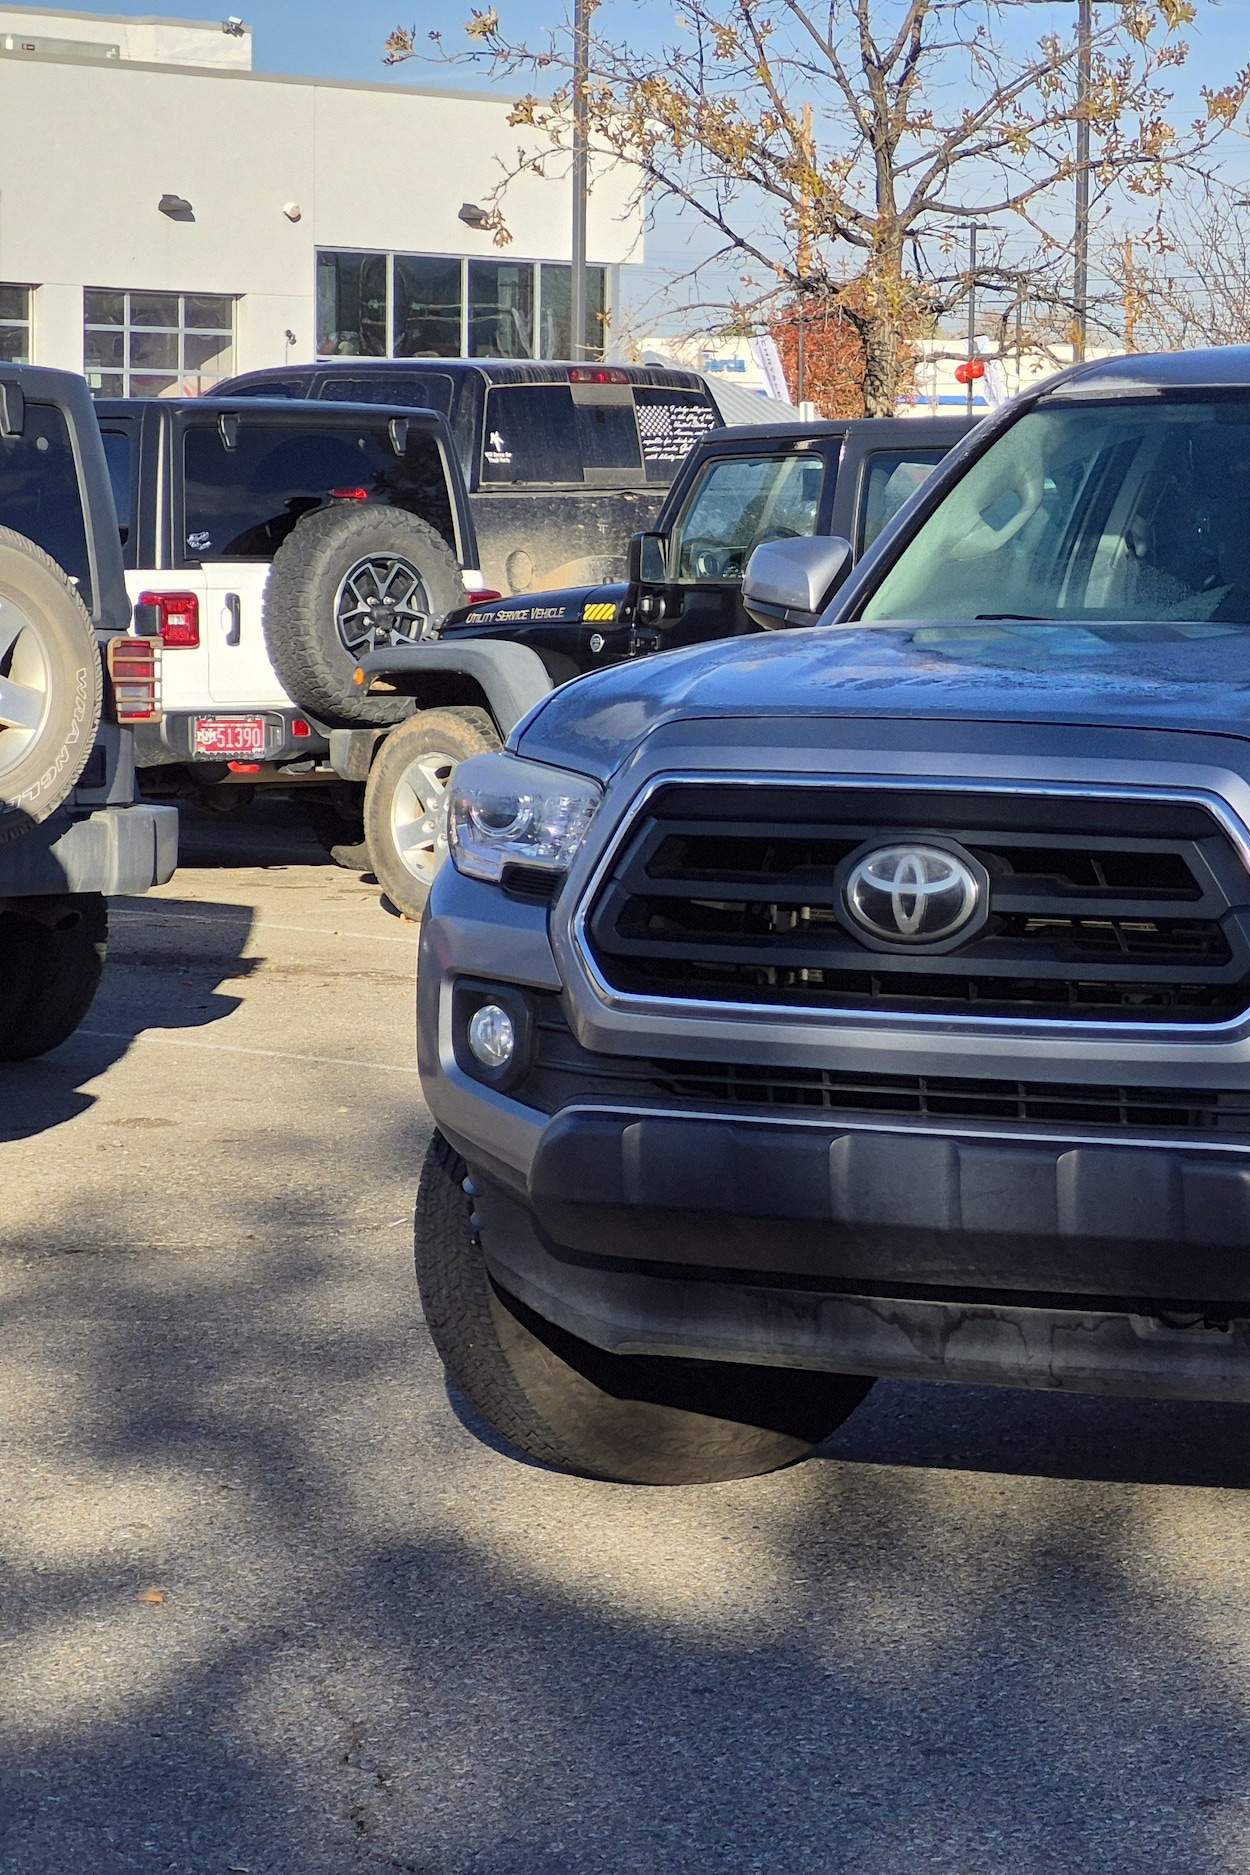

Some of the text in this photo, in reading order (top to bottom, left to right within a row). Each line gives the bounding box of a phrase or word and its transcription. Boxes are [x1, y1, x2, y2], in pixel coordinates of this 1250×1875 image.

[760, 337, 783, 402] CHRYSLE
[465, 606, 566, 624] UTILITY SERVICE VEHICLE
[216, 727, 261, 748] 51390
